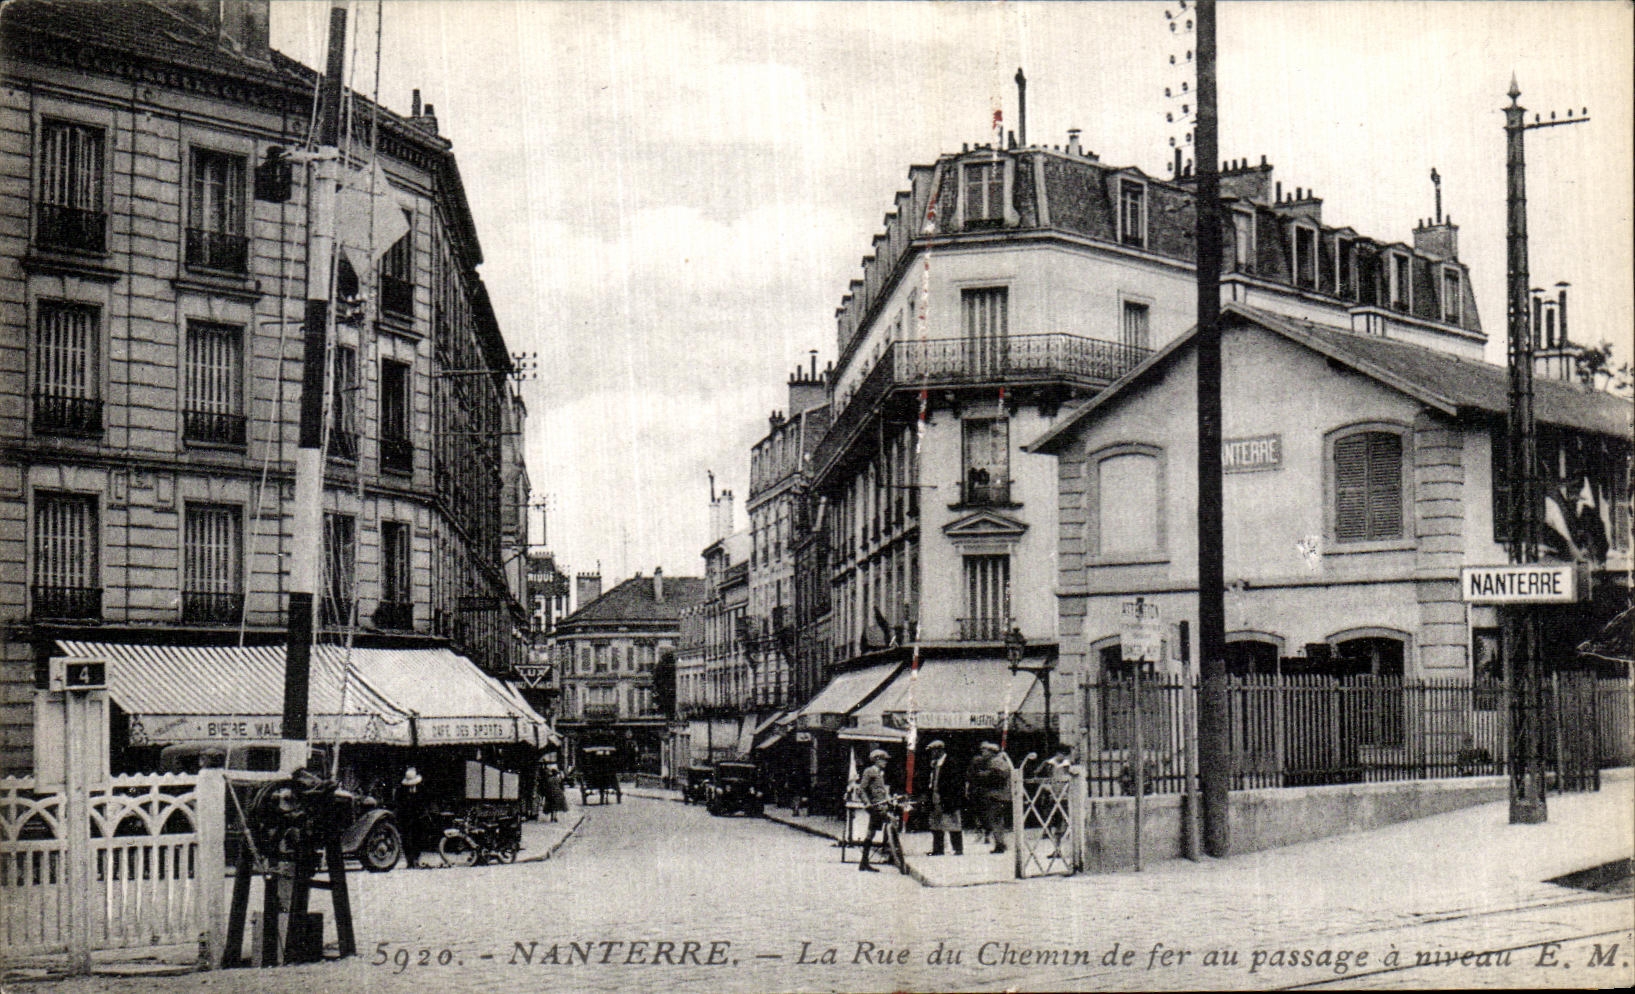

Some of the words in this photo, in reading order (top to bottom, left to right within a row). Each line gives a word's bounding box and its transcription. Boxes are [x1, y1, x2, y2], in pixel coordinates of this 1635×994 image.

[1222, 438, 1278, 467] NTERRE
[1470, 571, 1563, 596] NANTERRE
[79, 665, 90, 684] 4
[519, 668, 546, 678] LUX
